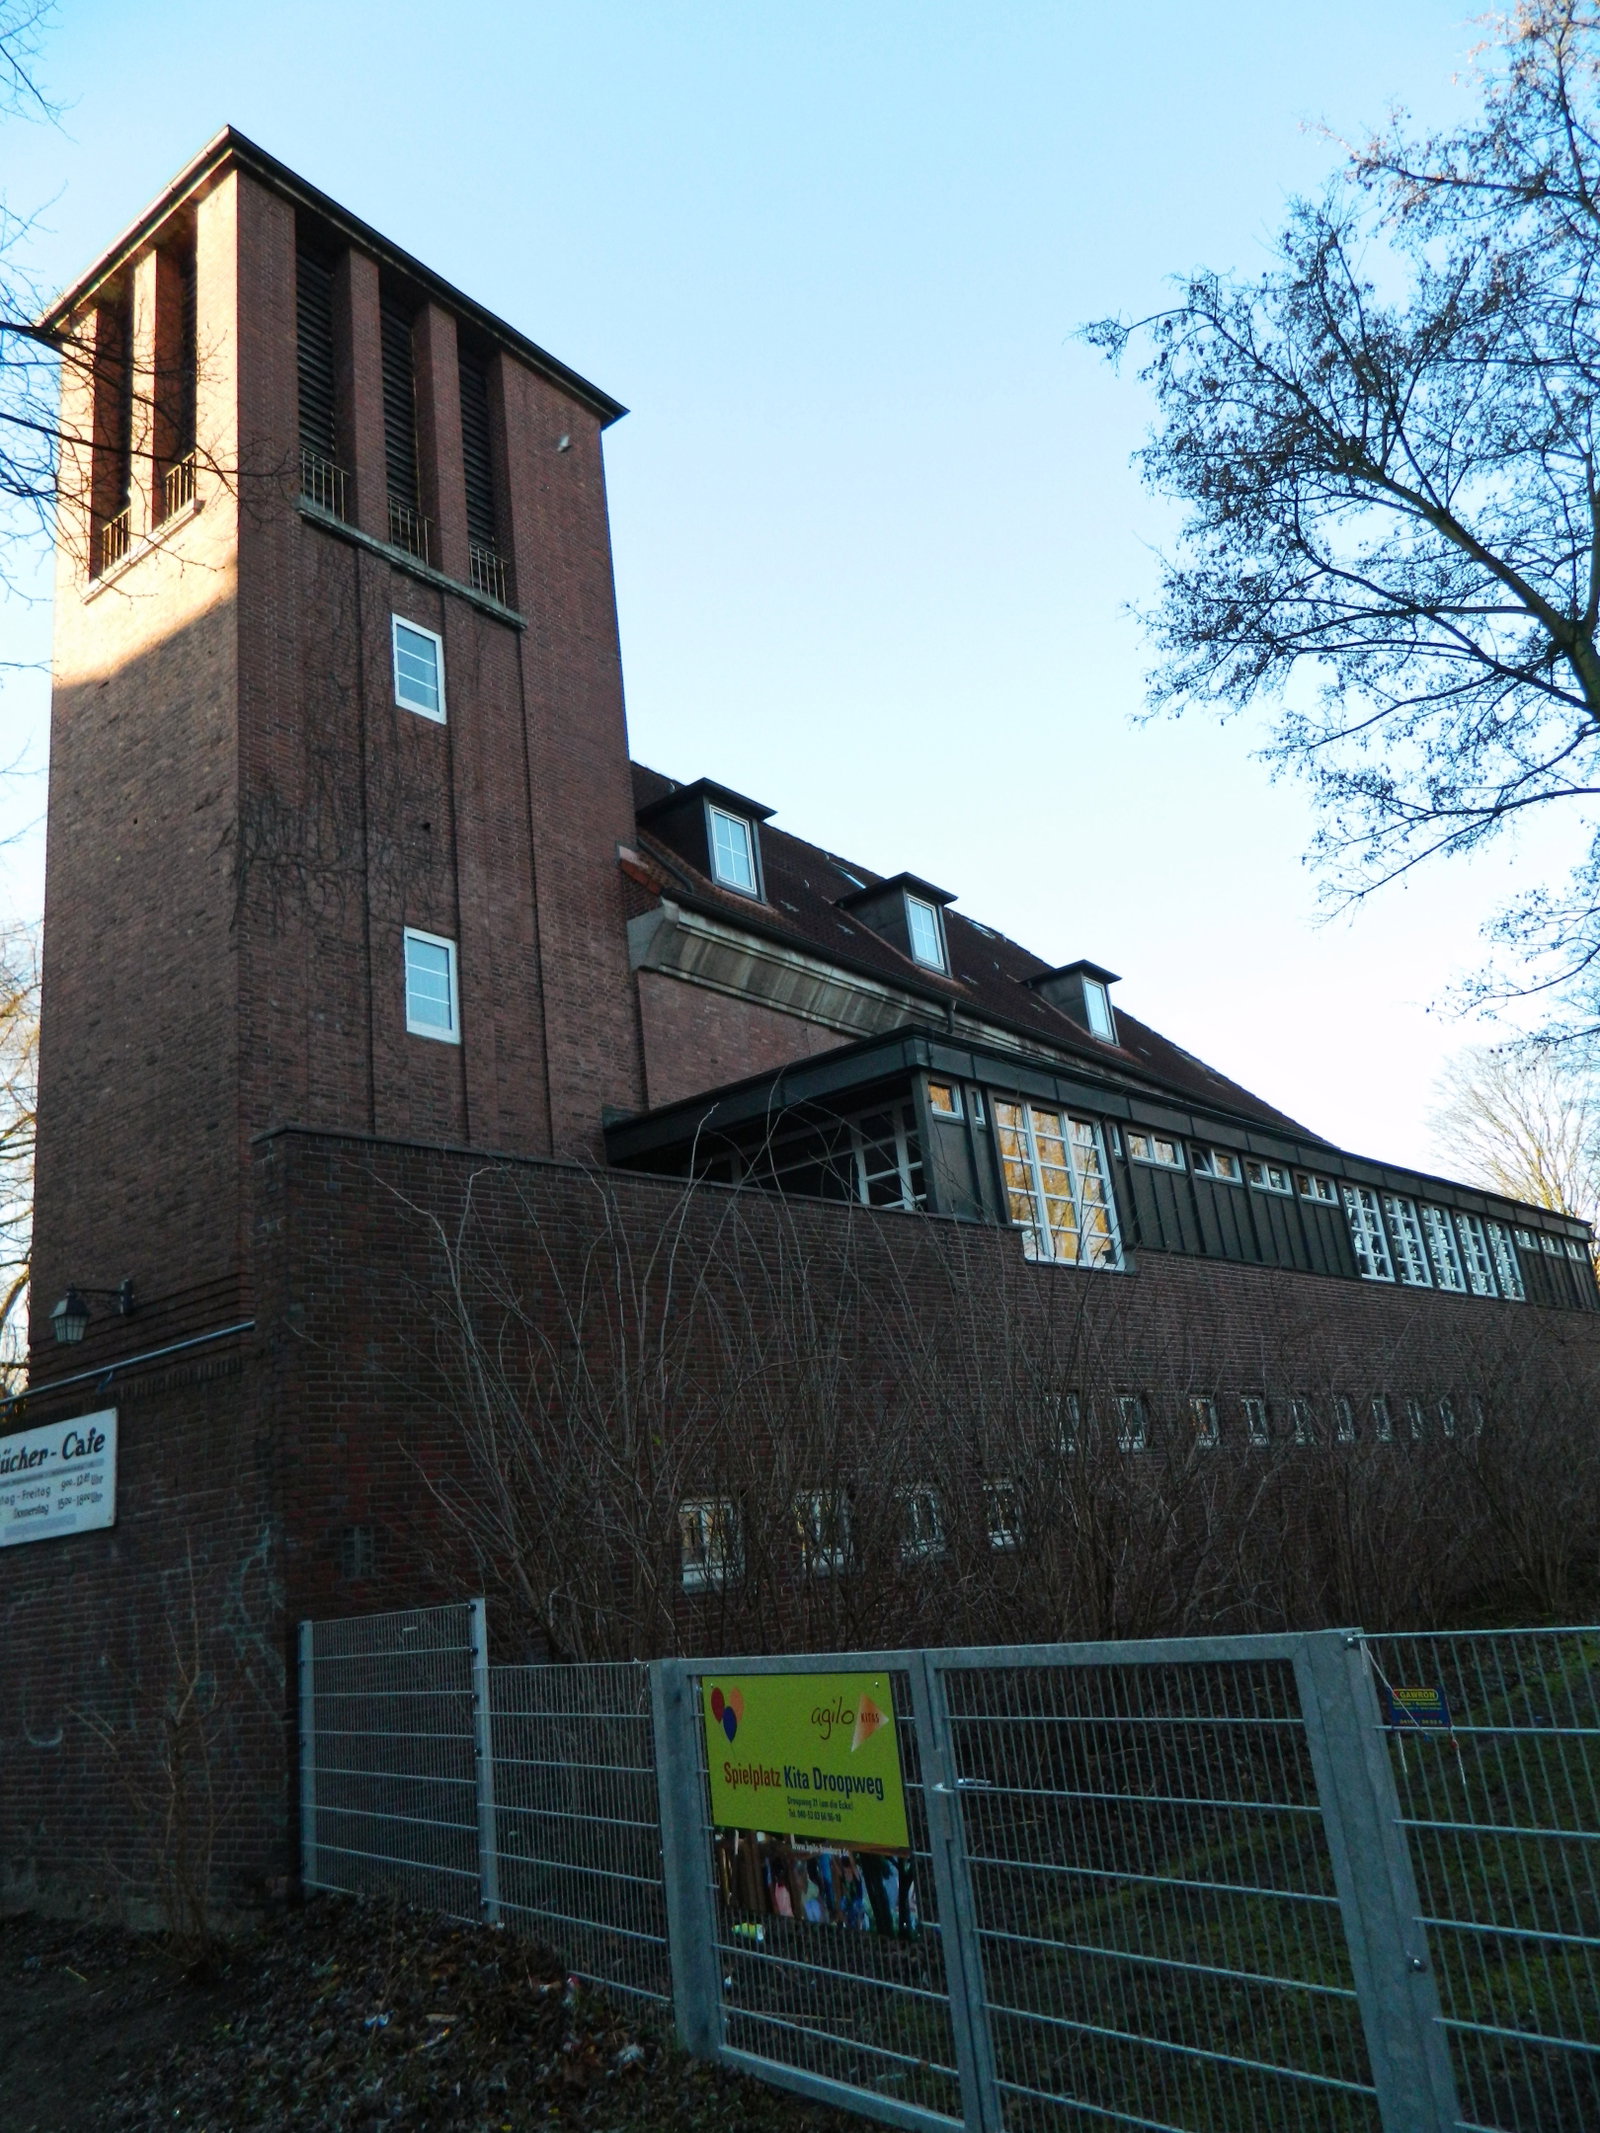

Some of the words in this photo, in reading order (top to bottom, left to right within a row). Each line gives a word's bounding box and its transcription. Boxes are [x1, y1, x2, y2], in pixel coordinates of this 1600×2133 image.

[811, 1696, 855, 1740] agilo
[724, 1761, 782, 1792] Spielplatz
[784, 1765, 810, 1790] Kita
[813, 1767, 885, 1801] Droopweg
